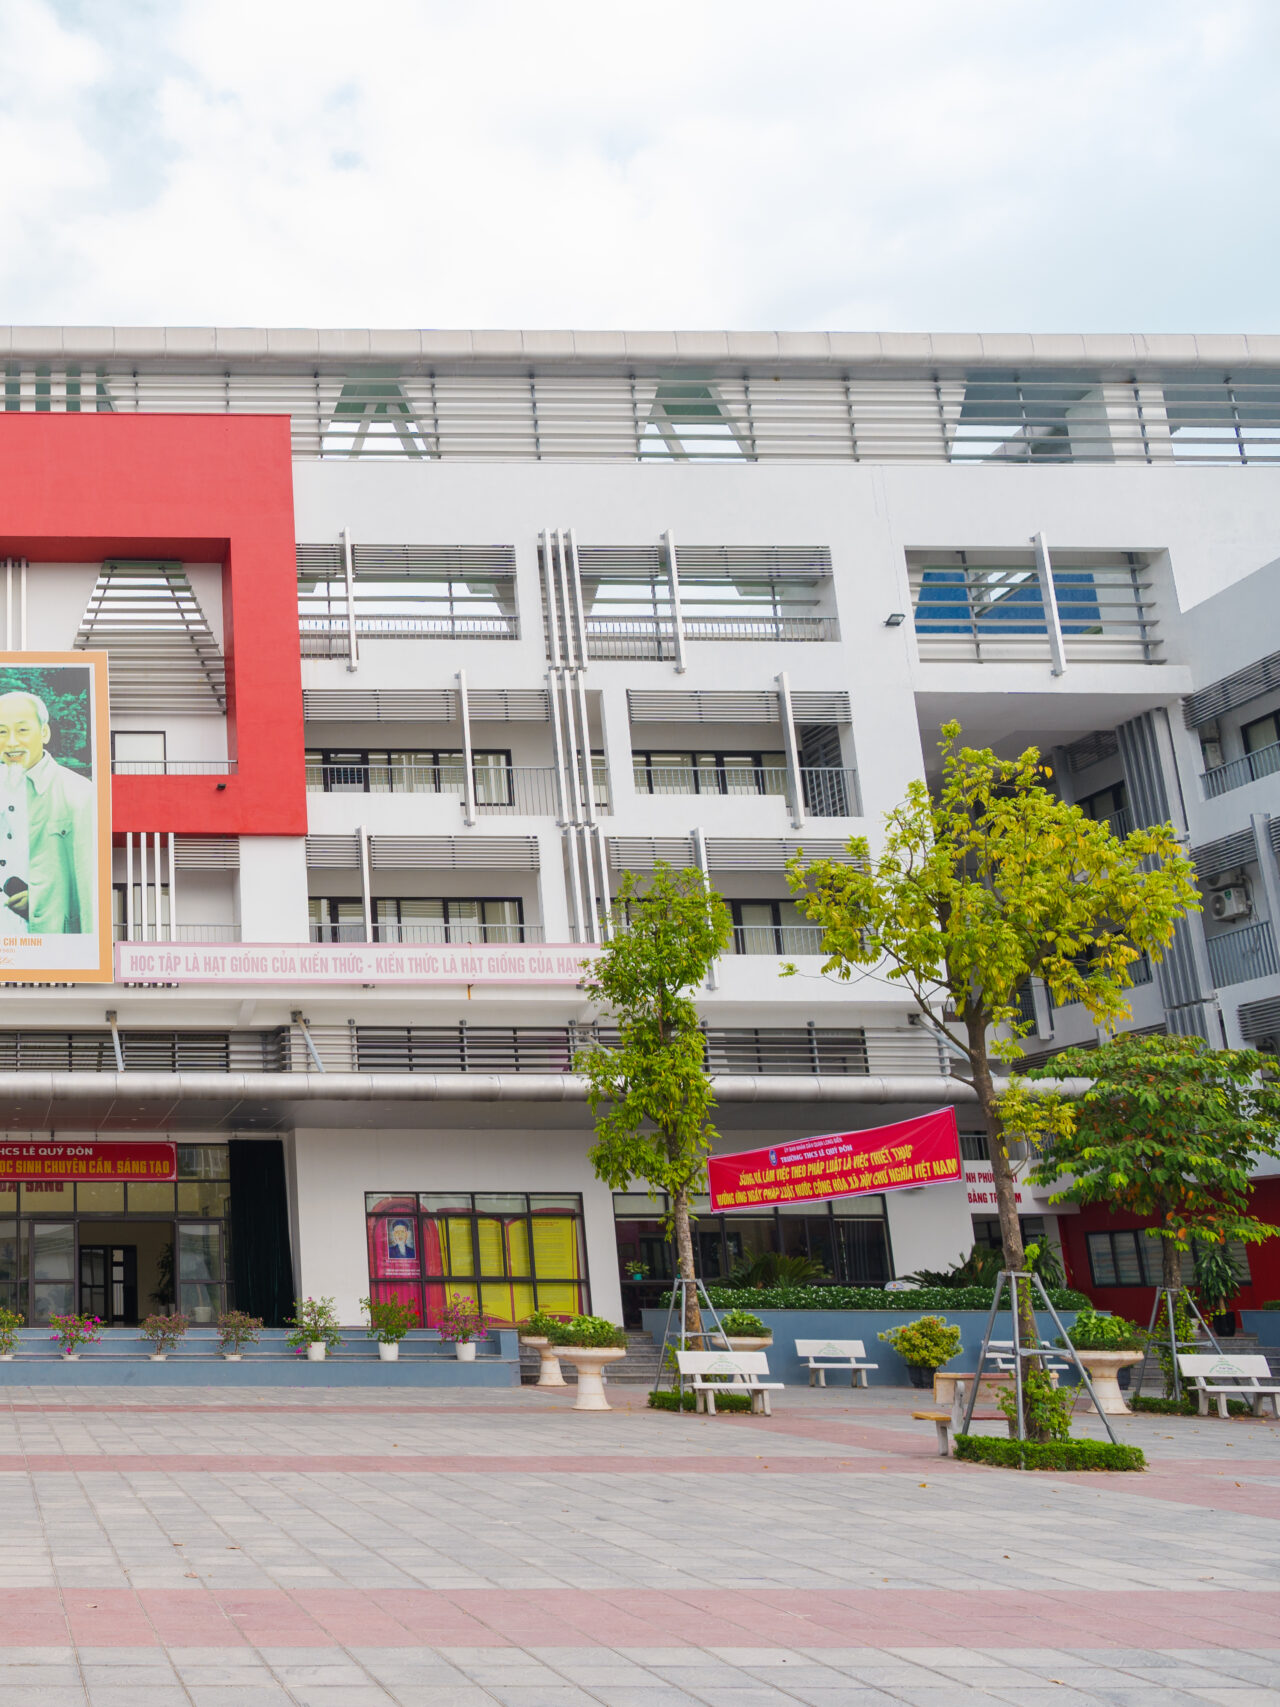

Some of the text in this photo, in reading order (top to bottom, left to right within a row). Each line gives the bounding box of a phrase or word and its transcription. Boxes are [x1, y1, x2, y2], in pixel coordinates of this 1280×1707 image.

[19, 937, 43, 947] MINH
[130, 954, 155, 976] HỌC
[159, 952, 182, 976] TẬP
[185, 951, 200, 973] LÀ
[203, 955, 227, 977] HẠT
[230, 950, 268, 974] GIỐNG
[271, 949, 297, 974] CỦA
[299, 950, 329, 974] KIẾN
[332, 951, 364, 974] THỨC
[375, 951, 405, 974] KIẾN
[408, 952, 439, 974] THỨC
[442, 953, 457, 974] LÀ
[461, 955, 484, 977] HẠT
[487, 950, 525, 974] GIỐNG
[528, 949, 554, 974] CỦA
[22, 1145, 36, 1156] LÊ
[38, 1145, 64, 1156] QUÝ
[66, 1145, 93, 1156] ĐÔN
[780, 1152, 803, 1163] TRƯỜNG
[803, 1151, 818, 1160] THCS
[15, 1159, 42, 1174] SINH
[44, 1157, 87, 1174] CHUYÊN
[117, 1156, 147, 1174] SÁNG
[149, 1160, 170, 1177] TẠO
[739, 1169, 755, 1186] SỐNG
[776, 1165, 790, 1184] VIỆC
[791, 1164, 806, 1180] THEO
[807, 1160, 824, 1177] PHÁP
[826, 1156, 842, 1175] LUẬT
[843, 1153, 852, 1171] LÀ
[853, 1151, 869, 1171] VIỆC
[870, 1144, 890, 1165] THIẾT
[891, 1144, 913, 1160] THỰC
[762, 1184, 780, 1200] PHÁP
[813, 1177, 833, 1197] CỘNG
[833, 1175, 849, 1192] HÒA
[849, 1173, 860, 1189] XÃ
[888, 1164, 913, 1182] NGHĨA
[914, 1159, 932, 1181] VIỆT
[932, 1158, 958, 1176] NAM
